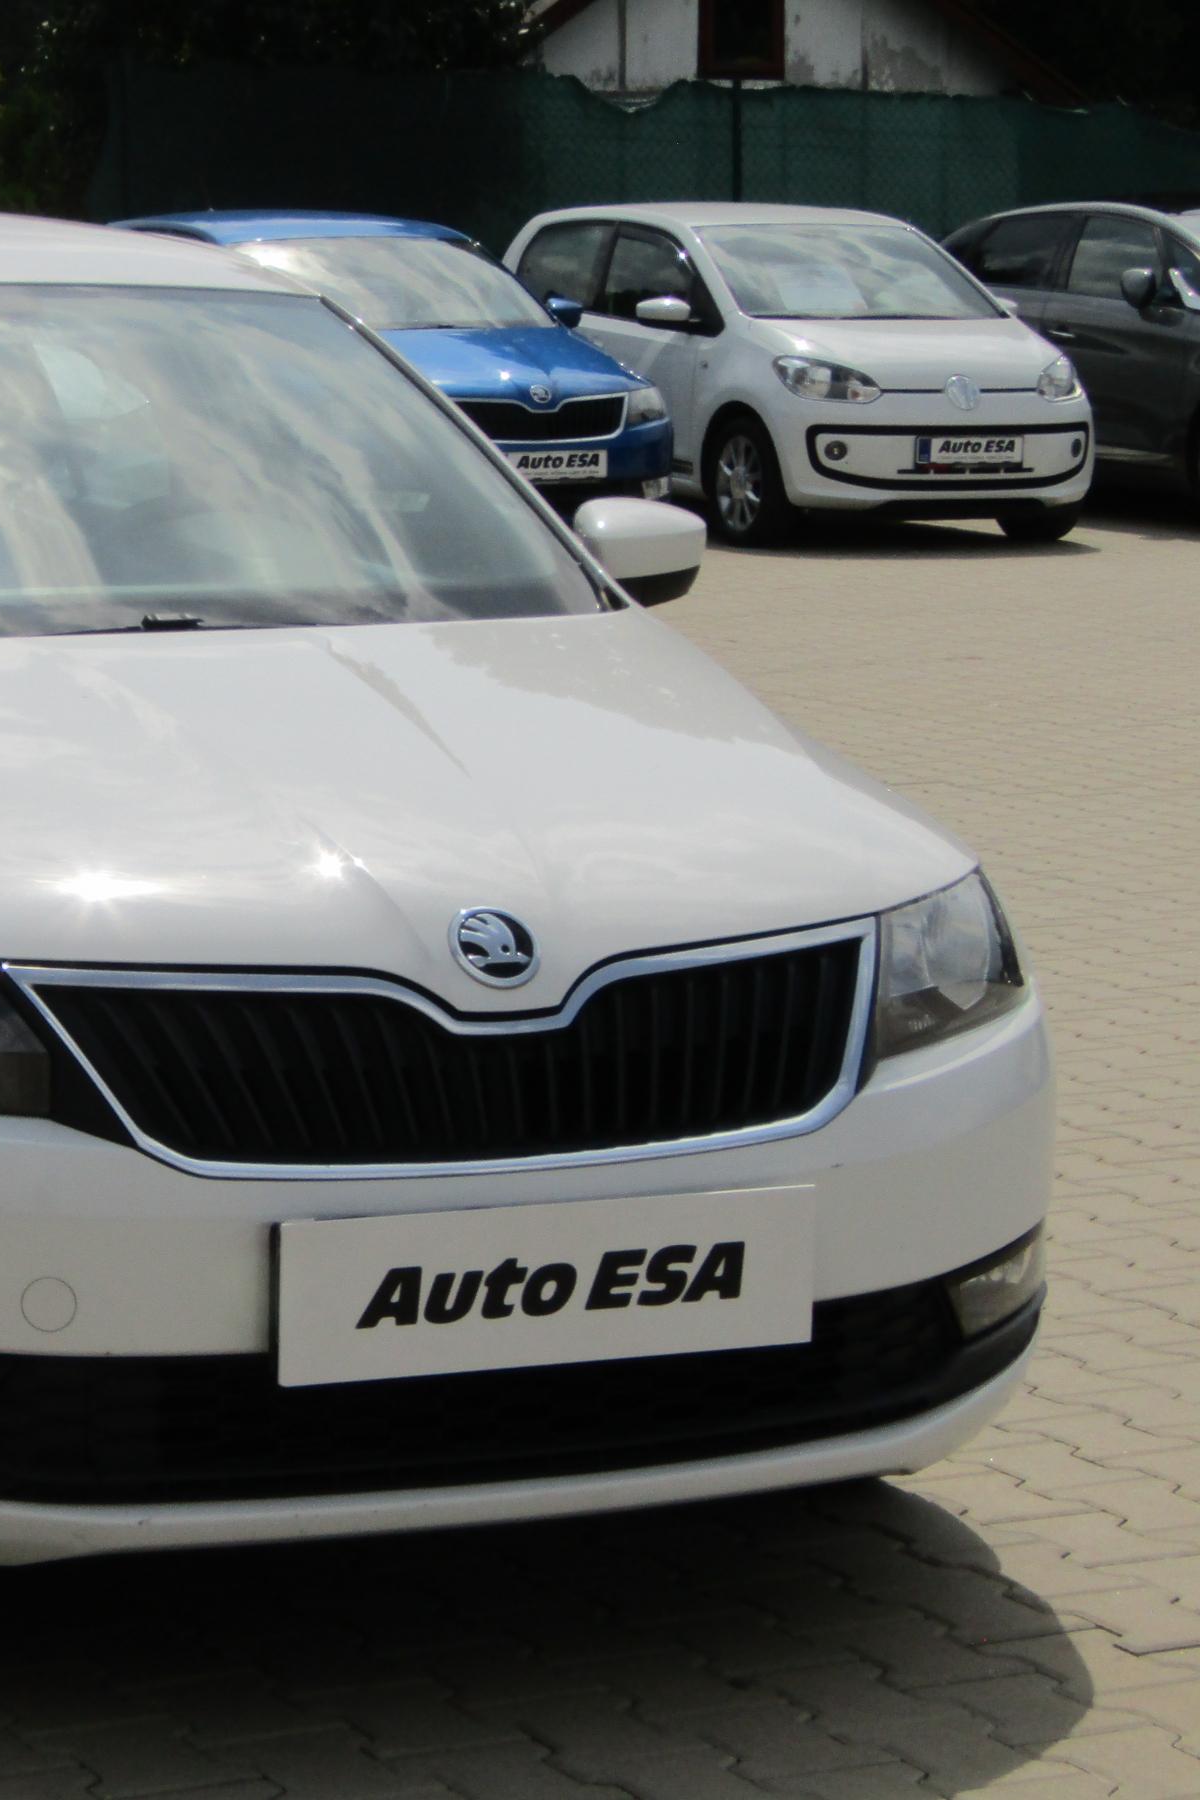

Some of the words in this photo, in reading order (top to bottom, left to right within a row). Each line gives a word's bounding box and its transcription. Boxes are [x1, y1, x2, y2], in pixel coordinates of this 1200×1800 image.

[938, 440, 982, 453] Auto
[983, 440, 1016, 453] ESA
[516, 455, 563, 469] Auto
[565, 453, 600, 468] ESA
[355, 1257, 578, 1329] Auto
[585, 1241, 745, 1310] ESA
